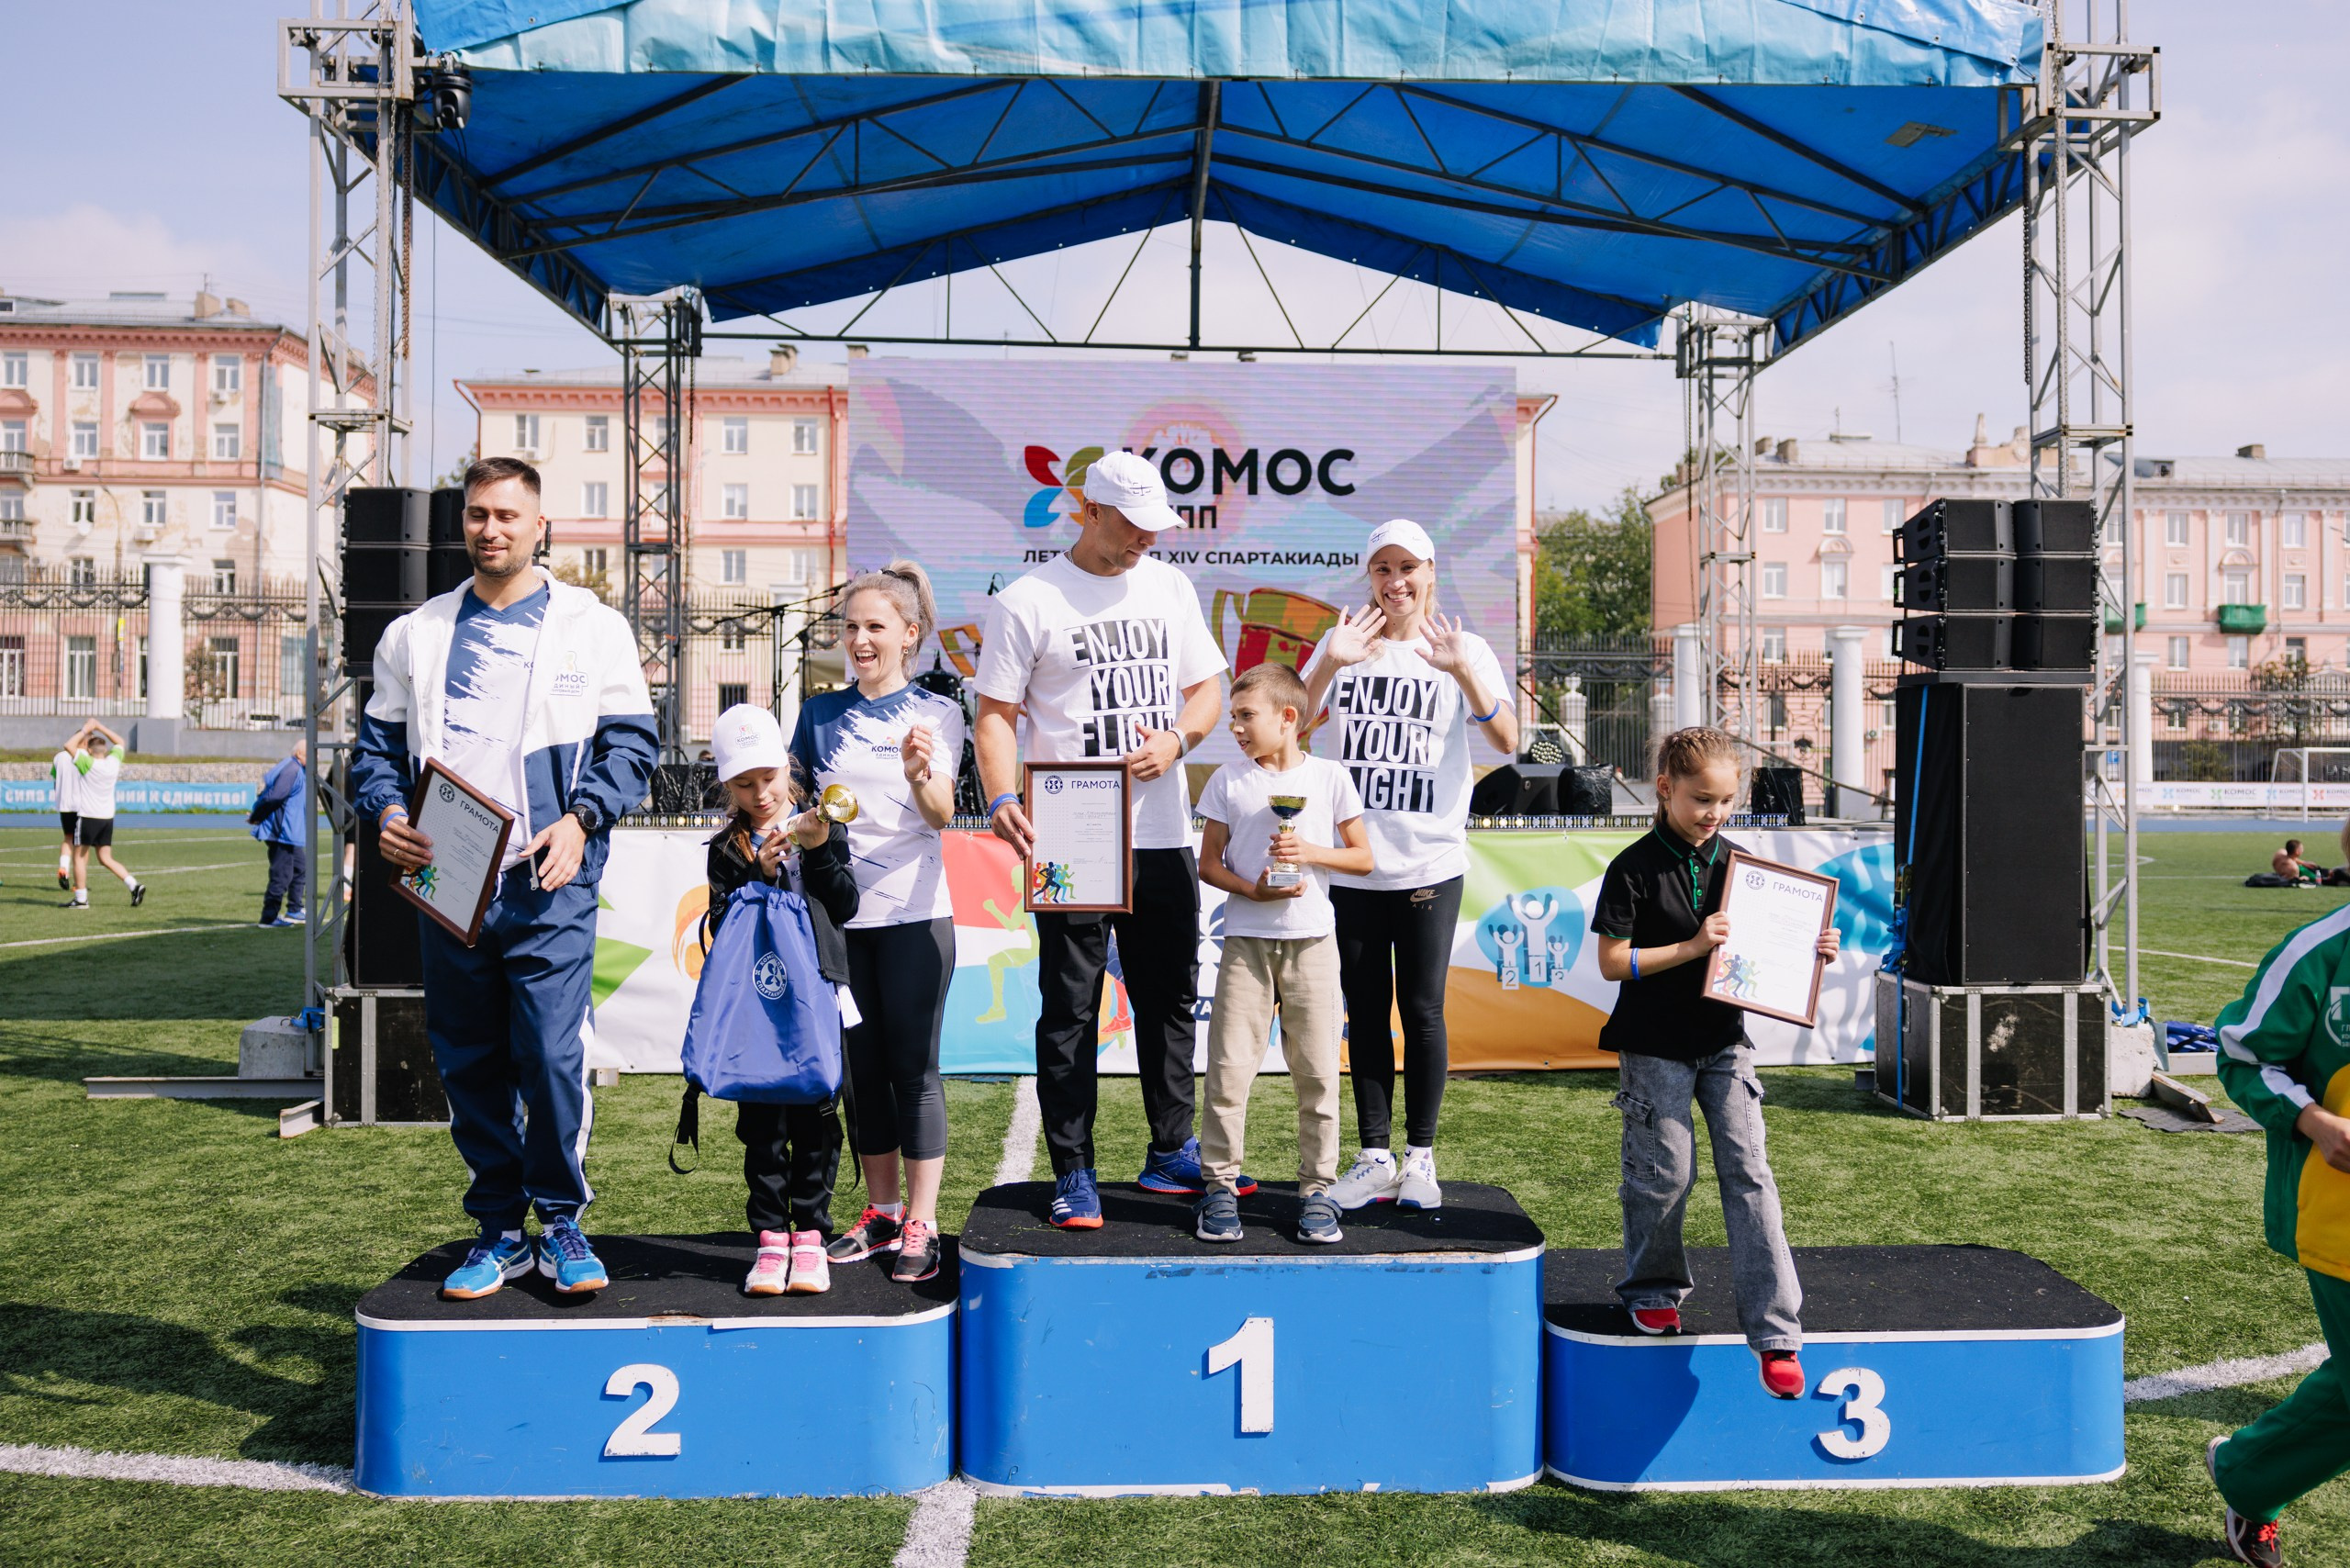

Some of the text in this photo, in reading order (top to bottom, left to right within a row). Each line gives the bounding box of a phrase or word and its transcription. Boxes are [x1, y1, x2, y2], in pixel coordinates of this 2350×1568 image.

[1170, 505, 1217, 529] ПП
[1024, 550, 1067, 563] ЛЕТ
[1169, 552, 1199, 565] XIV
[1207, 552, 1359, 567] СПАРТАКИАДЫ
[1070, 619, 1169, 668] ENJOY
[1091, 665, 1170, 711] YOUR
[1338, 676, 1439, 722] ENJOY
[1343, 720, 1430, 766] YOUR
[1071, 780, 1121, 790] ГРАМОТА
[1349, 767, 1435, 812] IGHT
[459, 800, 499, 834] ГРАМОТА
[1412, 902, 1433, 911] AIR
[1415, 889, 1436, 897] NIKE
[1773, 881, 1823, 902] ГРАМОТА
[1505, 969, 1517, 987] 2
[1534, 961, 1542, 978] 1
[1207, 1317, 1274, 1434] 1
[603, 1363, 682, 1458] 2
[1817, 1367, 1891, 1460] 3
